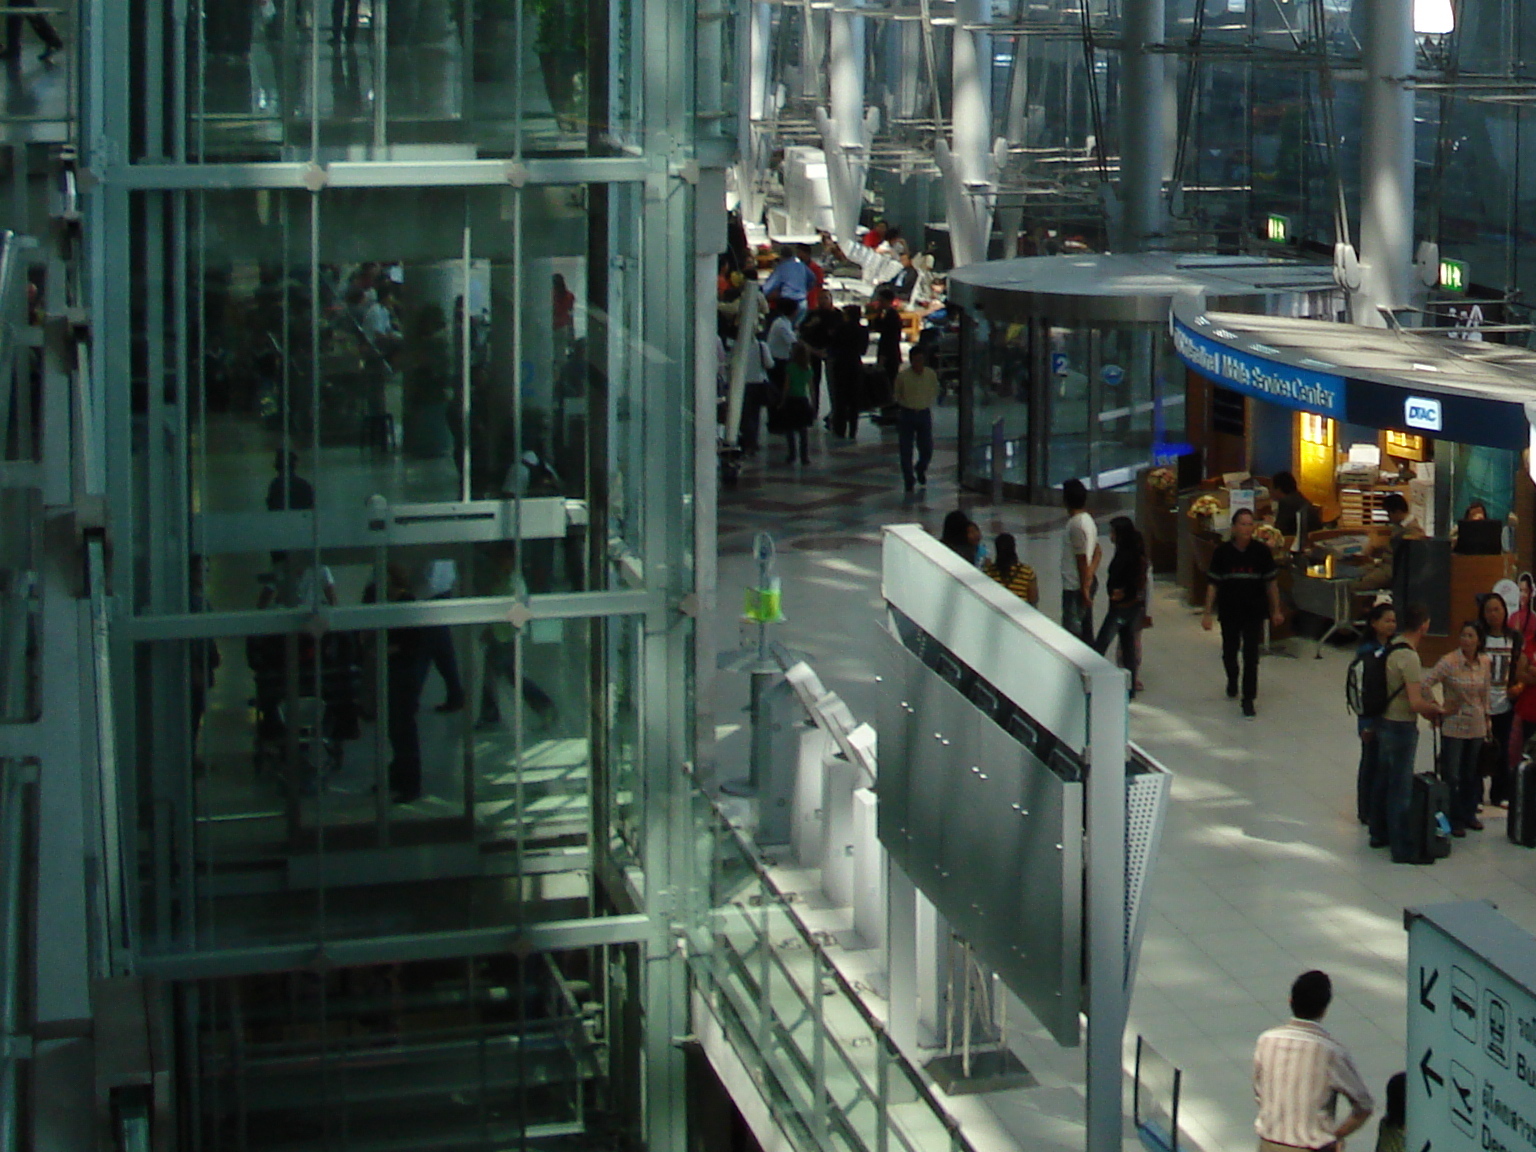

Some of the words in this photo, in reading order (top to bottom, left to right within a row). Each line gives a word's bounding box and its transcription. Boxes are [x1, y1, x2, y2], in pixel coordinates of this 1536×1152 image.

[1251, 366, 1291, 398] Service
[1292, 378, 1335, 409] Center
[1409, 406, 1437, 422] DTAC
